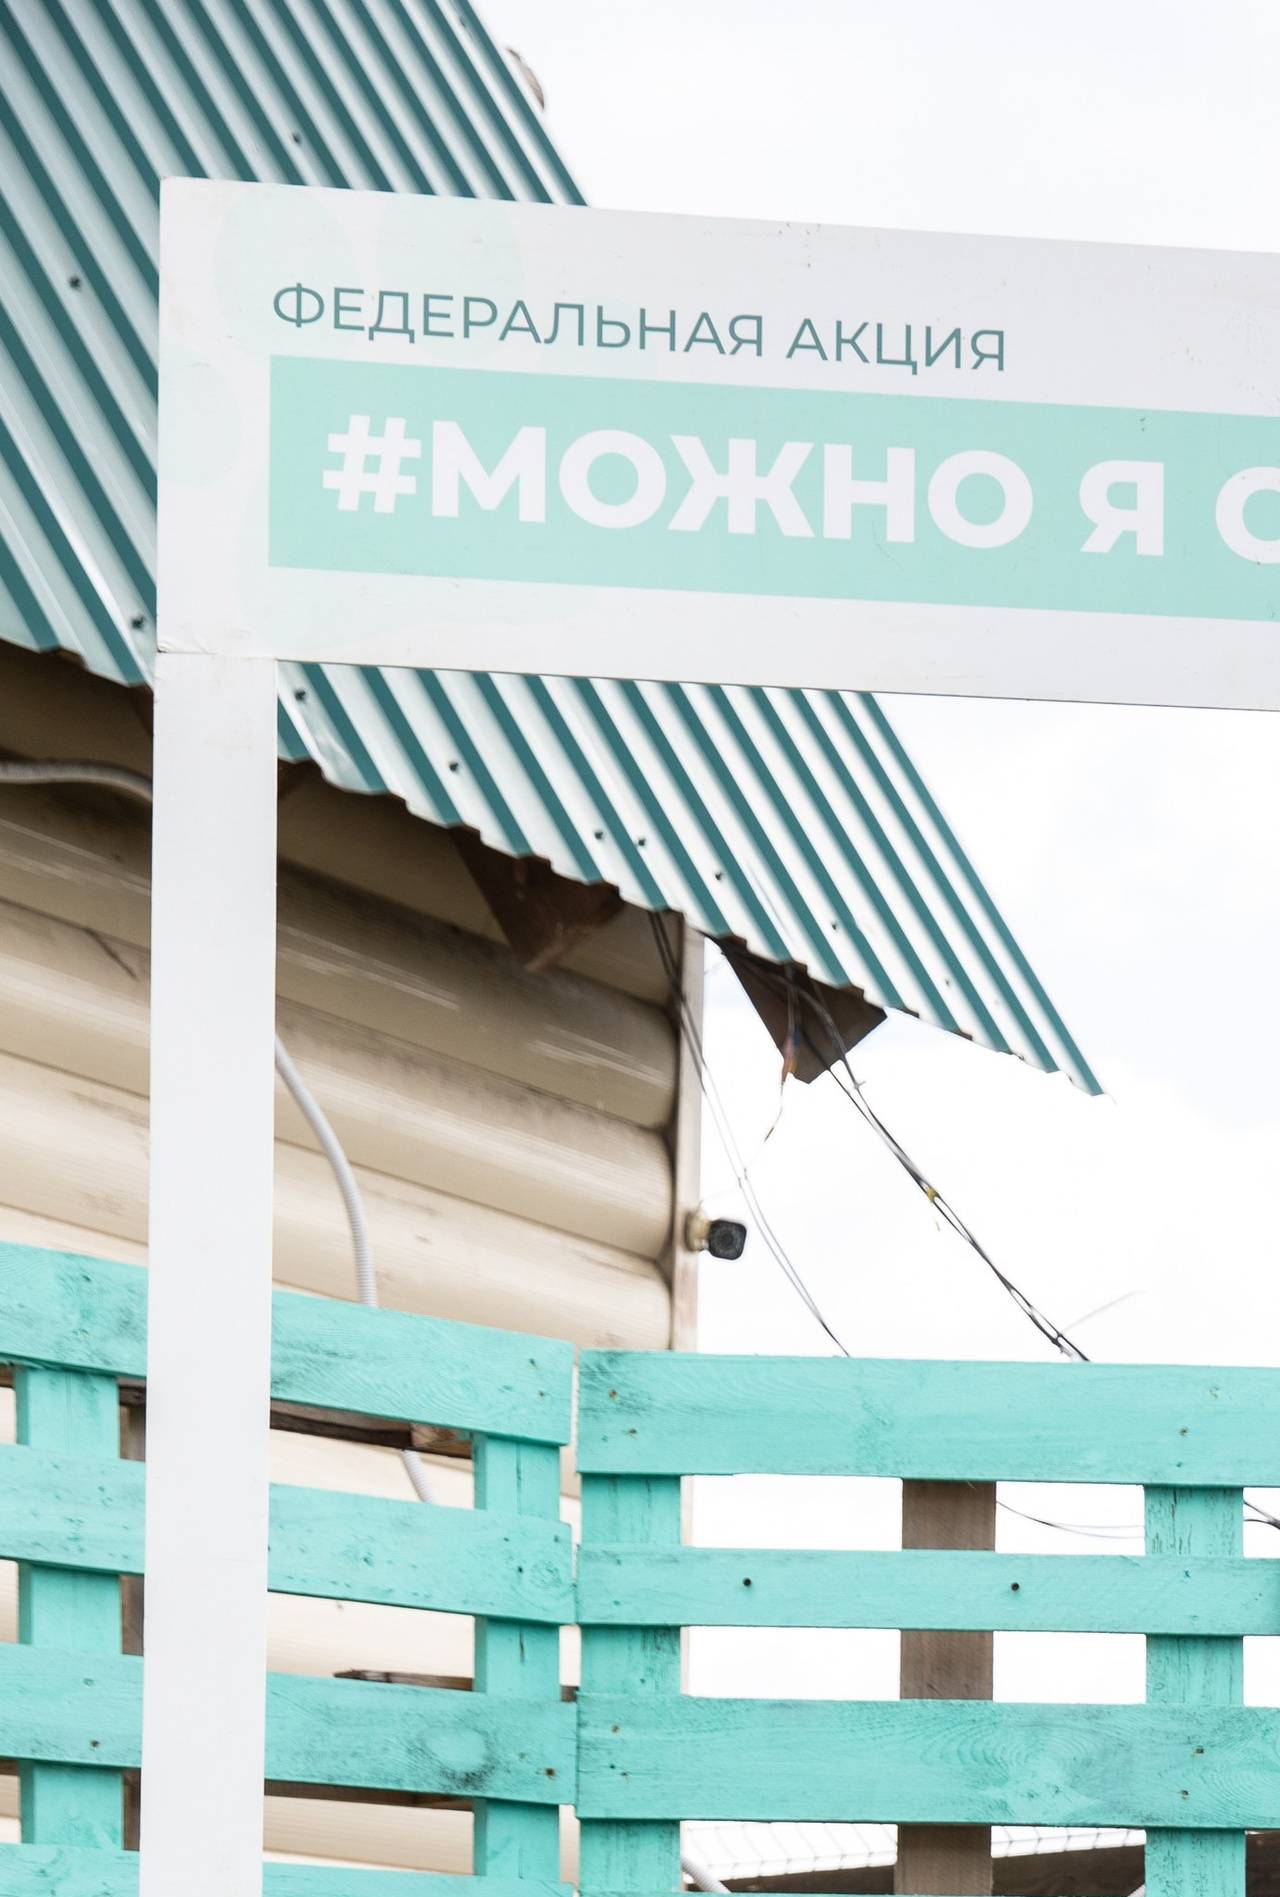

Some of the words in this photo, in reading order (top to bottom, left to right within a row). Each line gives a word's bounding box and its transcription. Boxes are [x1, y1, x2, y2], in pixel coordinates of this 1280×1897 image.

[272, 282, 764, 357] ФЕДЕРАЛЬНАЯ
[787, 317, 1006, 375] АКЦИЯ
[323, 414, 1034, 549] #МОЖНО
[1079, 459, 1164, 556] Я
